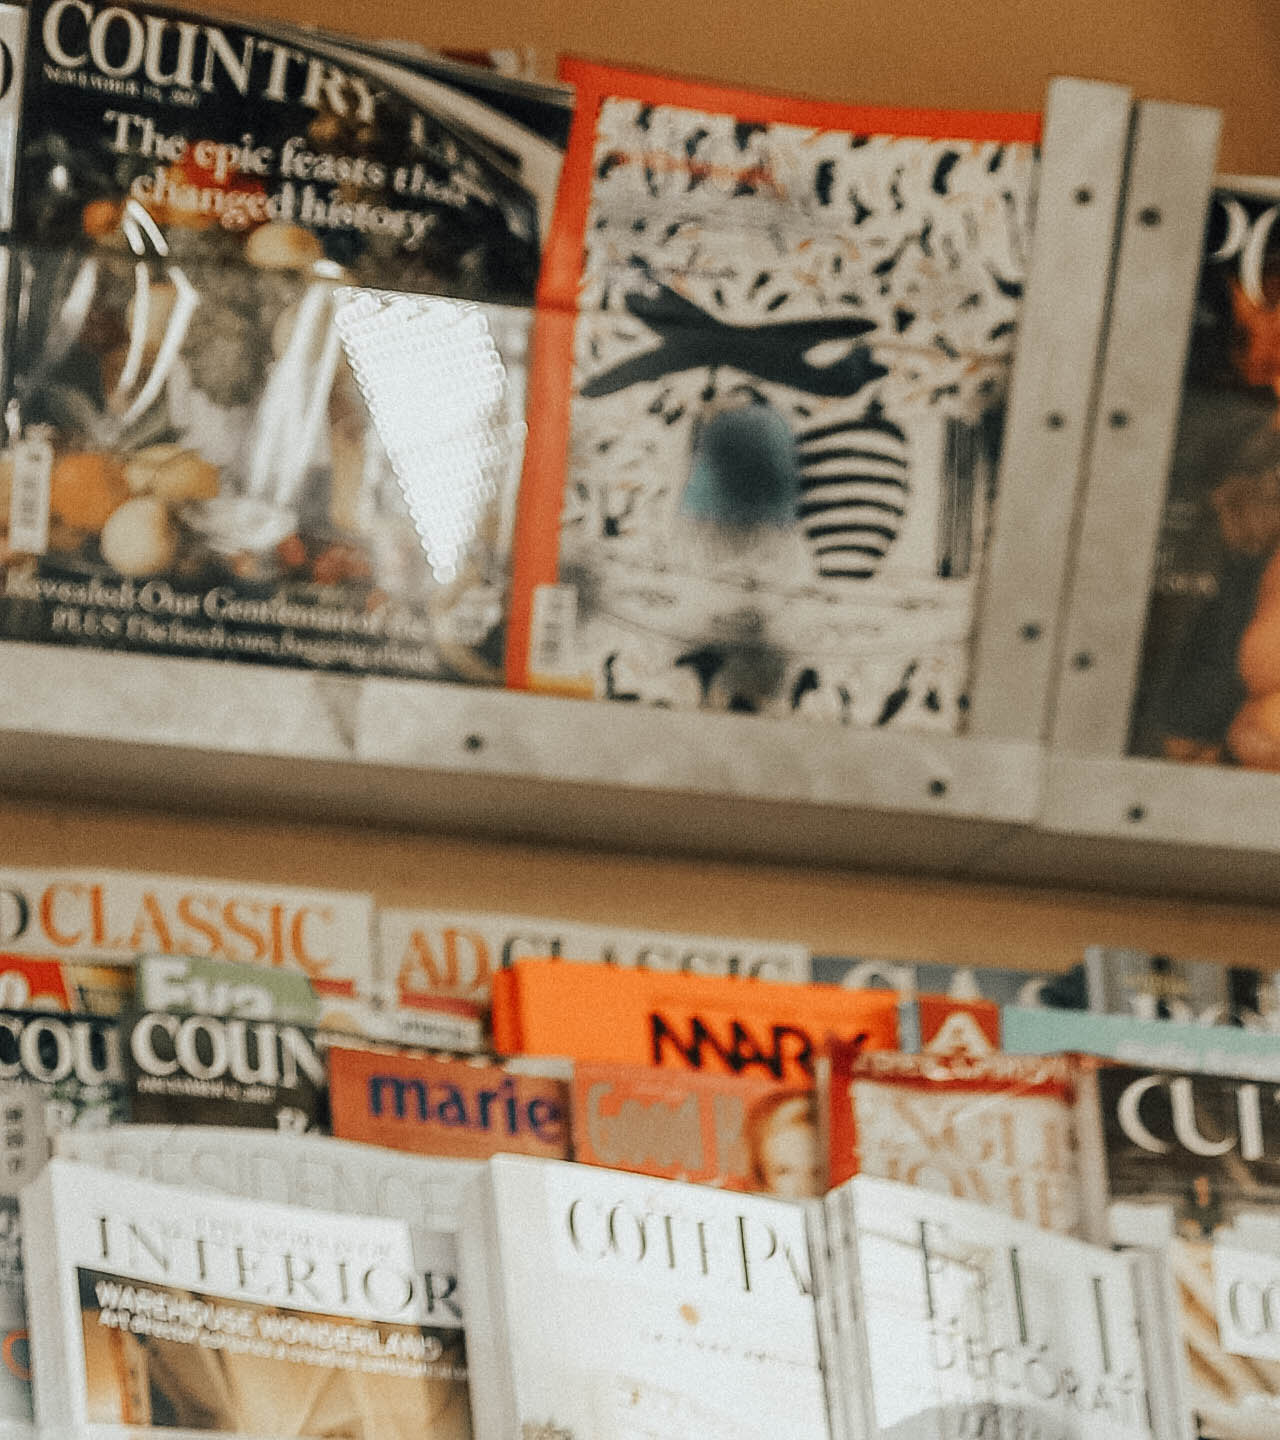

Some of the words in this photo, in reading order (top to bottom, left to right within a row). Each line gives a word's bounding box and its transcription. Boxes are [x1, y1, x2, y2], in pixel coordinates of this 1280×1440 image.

[41, 0, 382, 123] COUNTRY
[105, 110, 187, 161] The
[41, 883, 335, 975] CLASSIC
[366, 1073, 565, 1145] marie
